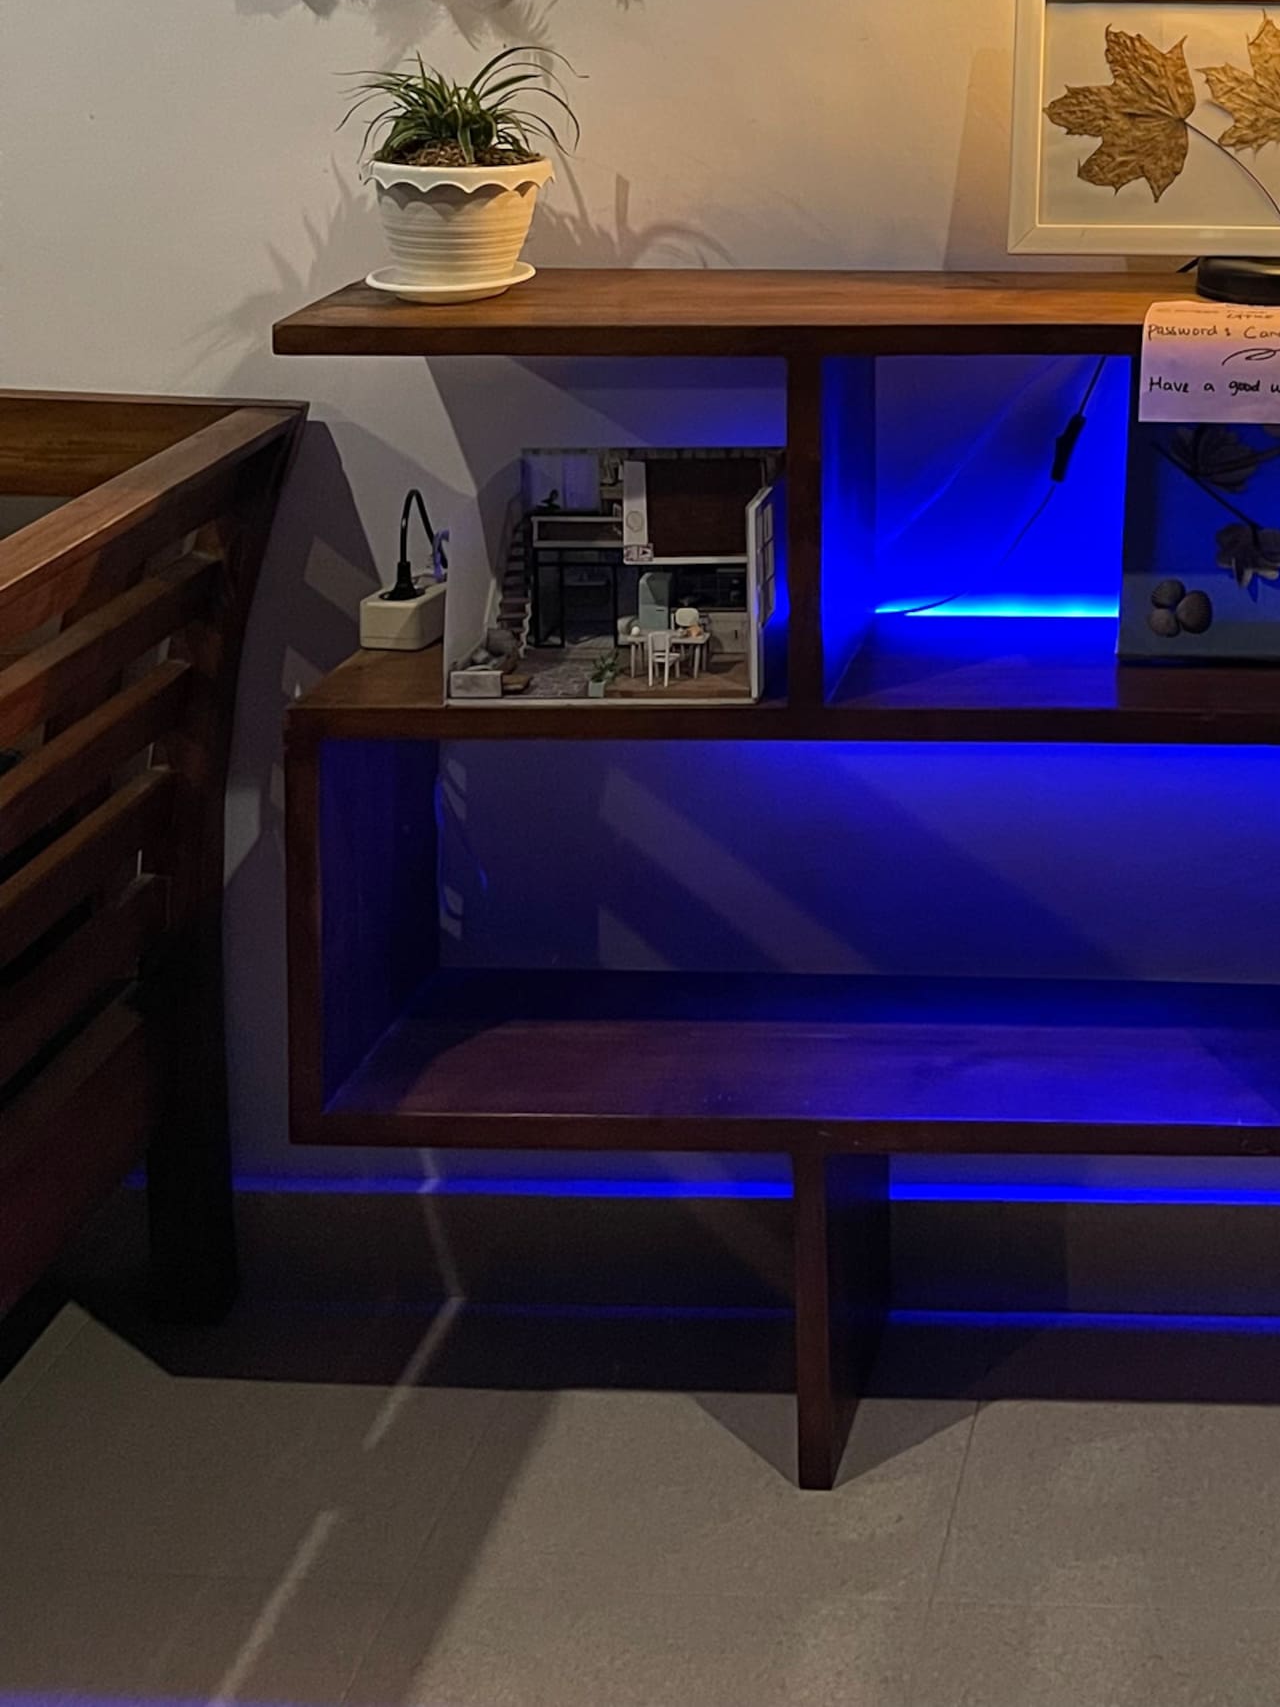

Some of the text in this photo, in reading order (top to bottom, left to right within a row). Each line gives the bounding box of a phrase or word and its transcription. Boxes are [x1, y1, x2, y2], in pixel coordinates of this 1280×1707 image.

[1149, 376, 1190, 394] Have
[1203, 382, 1216, 392] a
[1228, 379, 1261, 396] good
